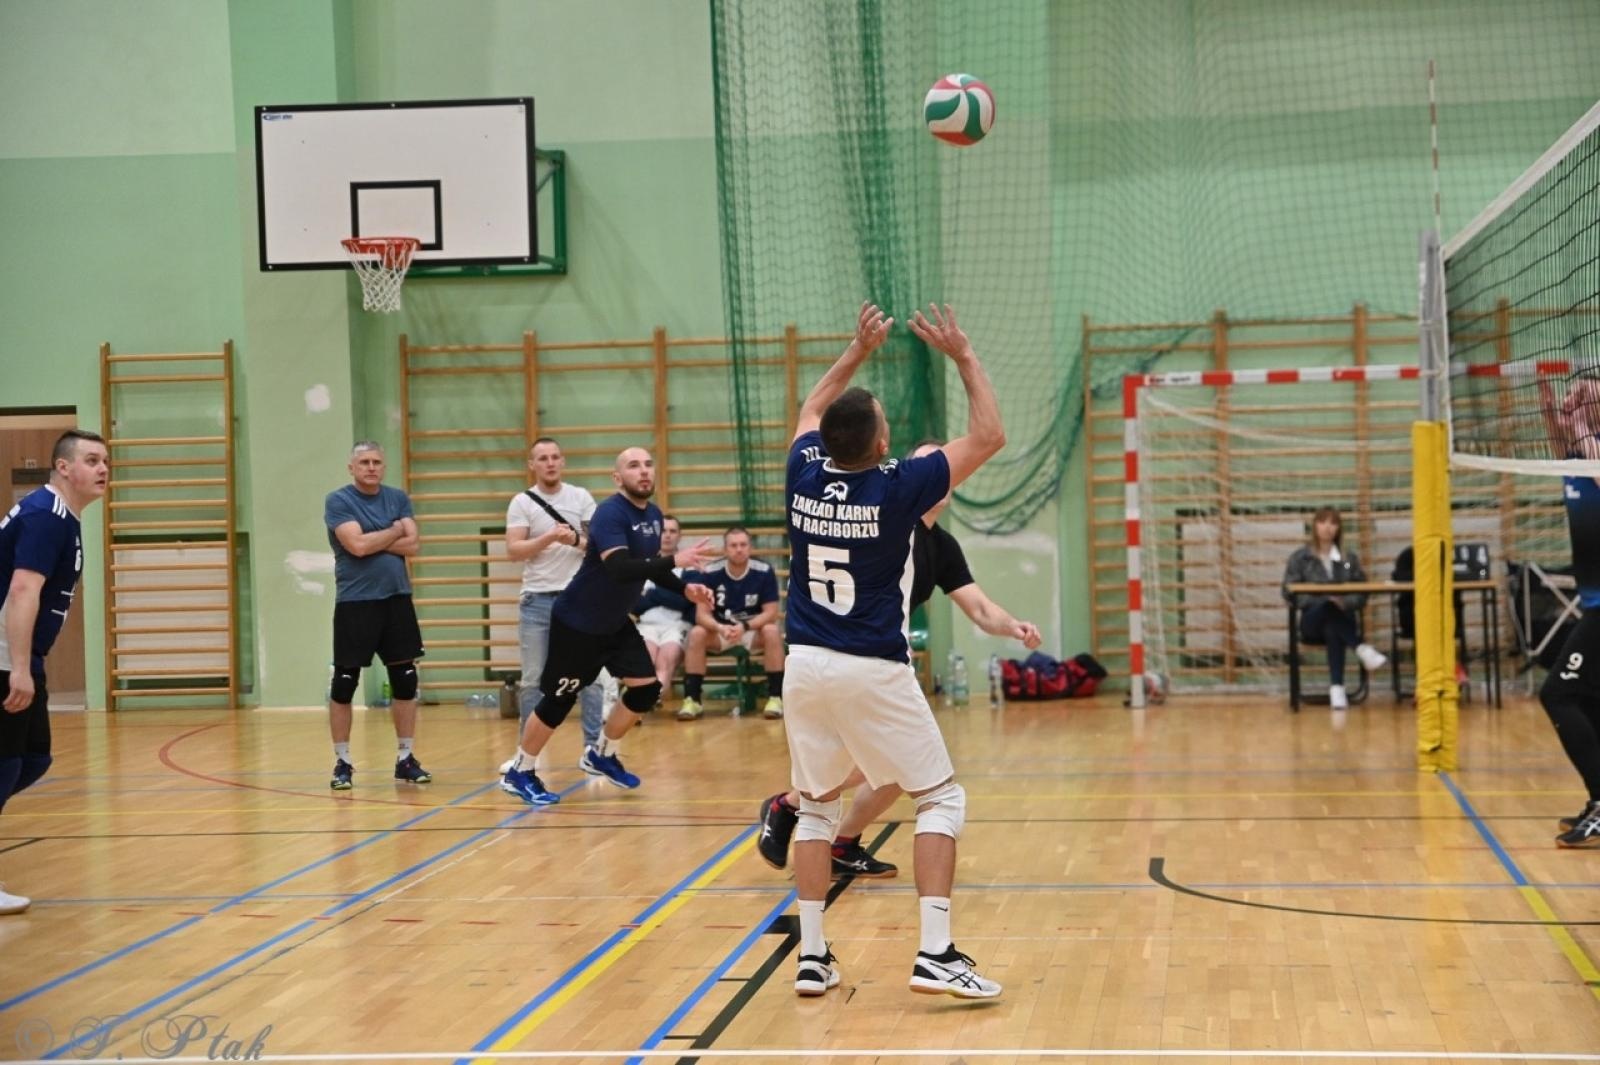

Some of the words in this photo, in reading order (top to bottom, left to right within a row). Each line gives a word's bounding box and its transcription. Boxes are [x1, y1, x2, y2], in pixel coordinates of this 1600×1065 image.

[792, 493, 835, 519] ZAKŁAD
[835, 504, 881, 521] KARNY
[791, 511, 802, 529] W
[802, 516, 880, 539] RACIBORZU
[808, 543, 856, 616] 5
[716, 592, 726, 607] 2
